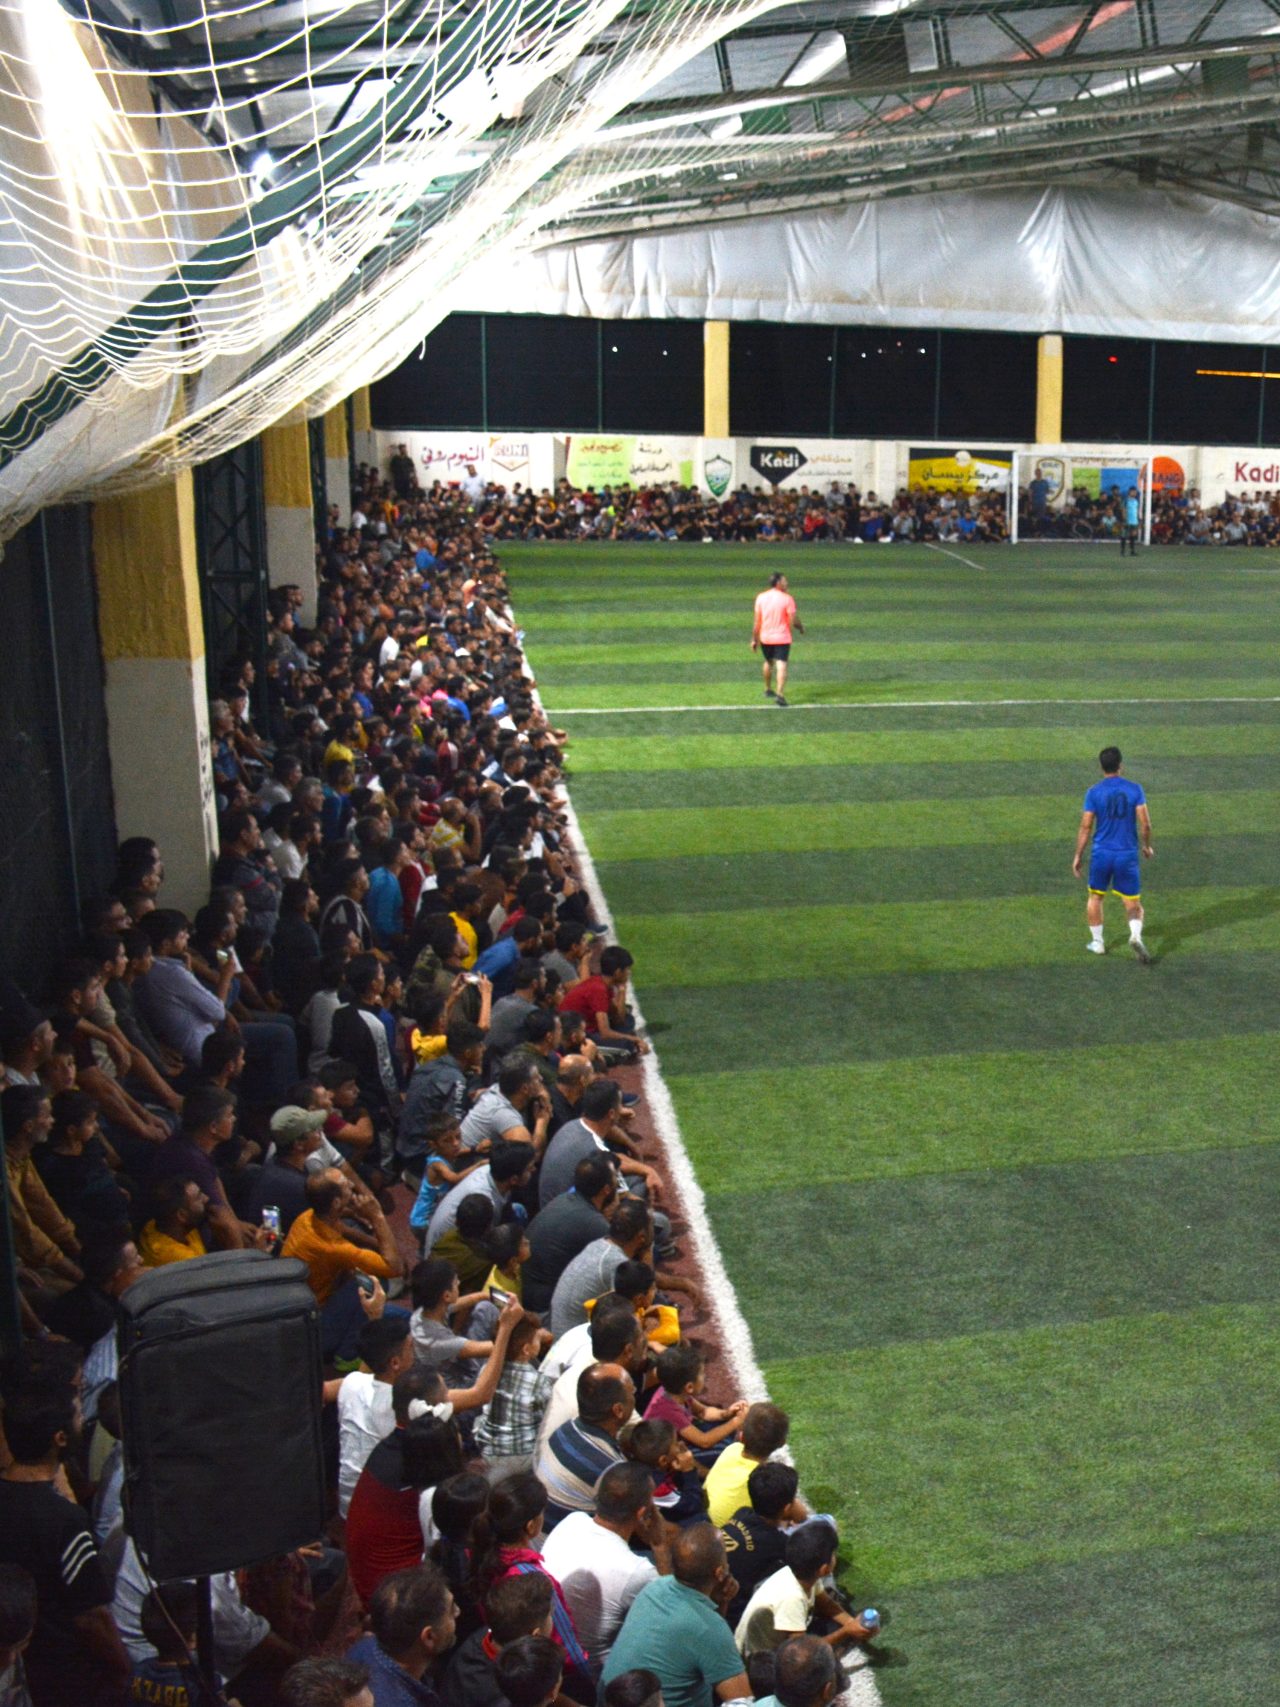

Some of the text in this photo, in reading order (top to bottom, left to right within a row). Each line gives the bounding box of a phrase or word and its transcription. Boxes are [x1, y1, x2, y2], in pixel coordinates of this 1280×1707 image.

[760, 452, 799, 468] Kadi
[1235, 461, 1280, 483] Kadi
[1106, 791, 1128, 819] 10
